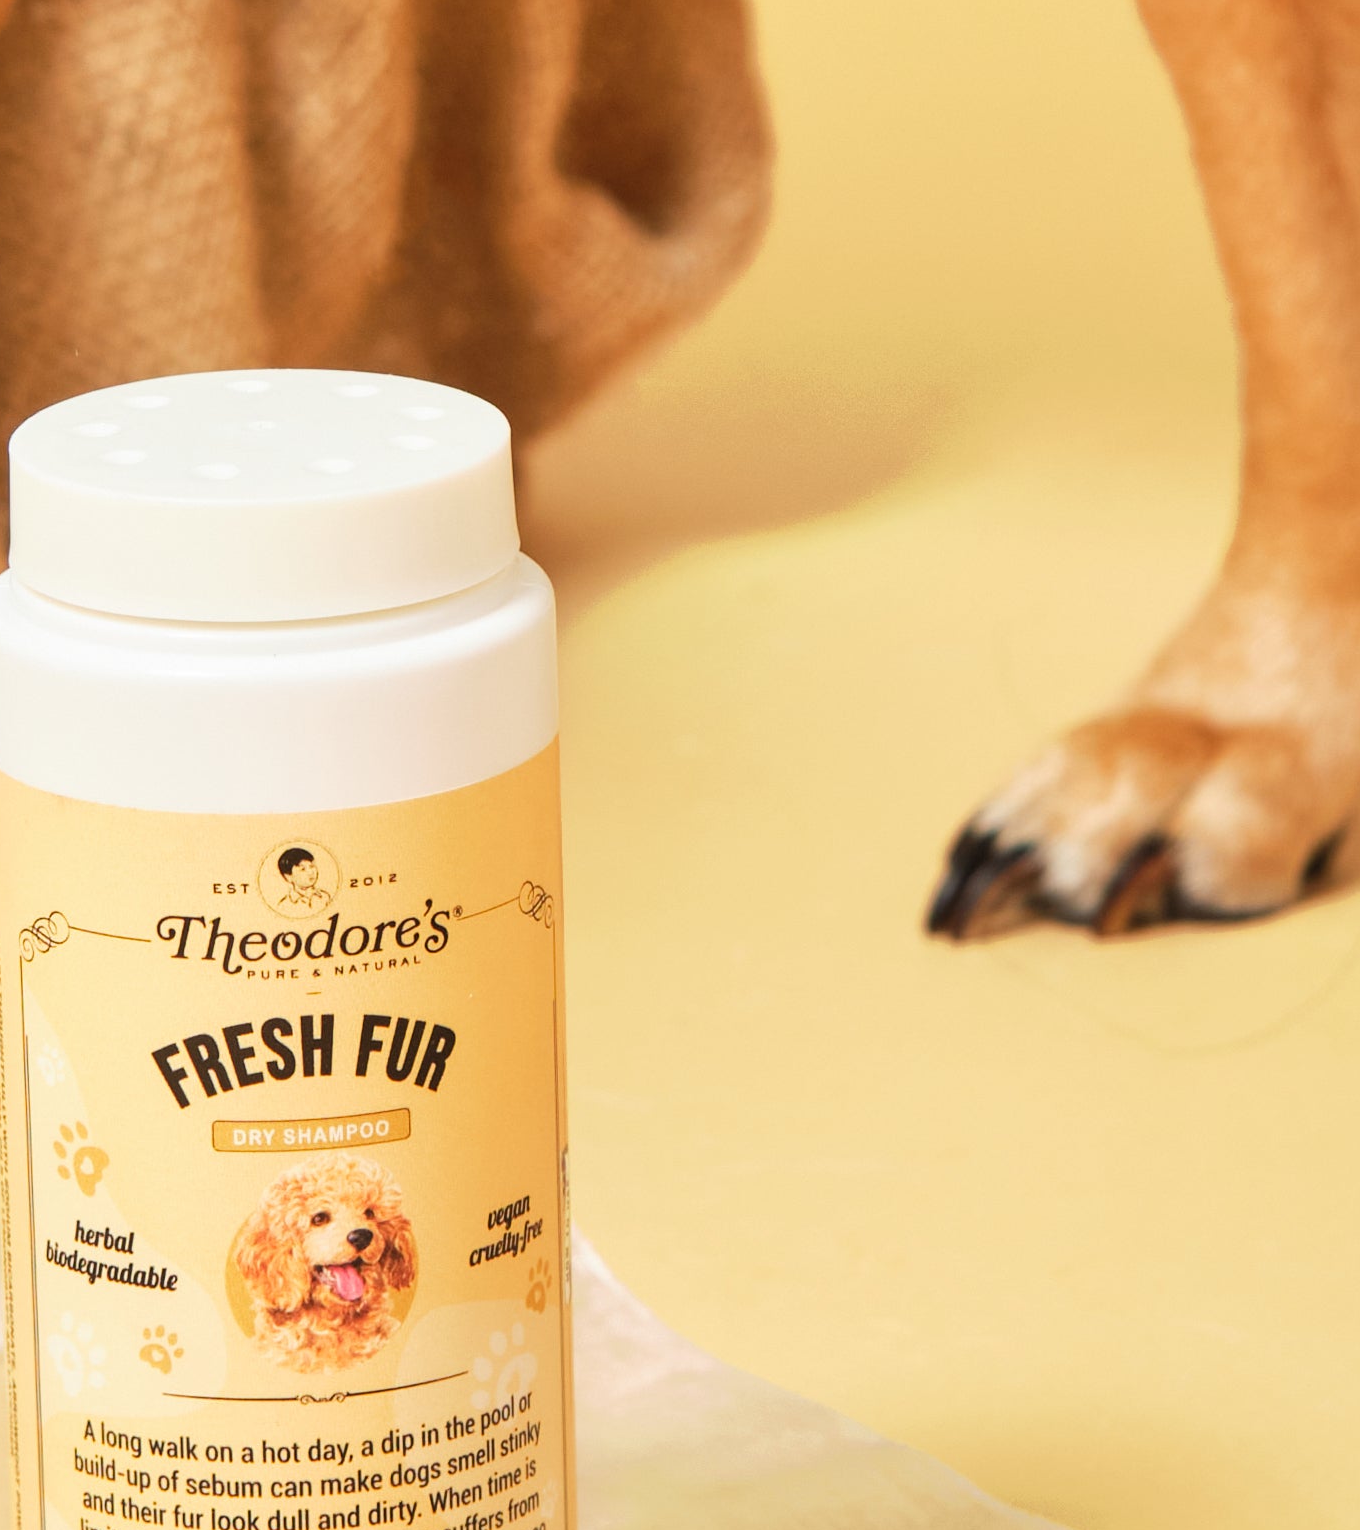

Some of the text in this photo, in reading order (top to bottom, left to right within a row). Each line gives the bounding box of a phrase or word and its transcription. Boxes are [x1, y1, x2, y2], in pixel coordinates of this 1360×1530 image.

[212, 873, 398, 895] EST 2012
[247, 955, 422, 979] PURE & NATURAL
[152, 1013, 457, 1109] FRESH FUR
[232, 1119, 390, 1147] DRY SHAMPOO
[487, 1194, 531, 1230] vegan
[74, 1221, 135, 1254] herbal
[468, 1217, 544, 1265] cruelty-free
[45, 1238, 178, 1291] biodegradable
[83, 1391, 532, 1466] A long walk on a hot day, a dip in the pool or
[74, 1419, 541, 1498] build-up of sebum can make dogs smell stinky
[83, 1491, 115, 1515] and
[121, 1497, 166, 1526] their
[173, 1504, 205, 1529] fur
[317, 1506, 361, 1530] and
[369, 1500, 422, 1528] dirty.
[429, 1485, 482, 1513] When
[488, 1468, 522, 1496] time
[525, 1457, 537, 1480] is
[508, 1490, 540, 1522] from
